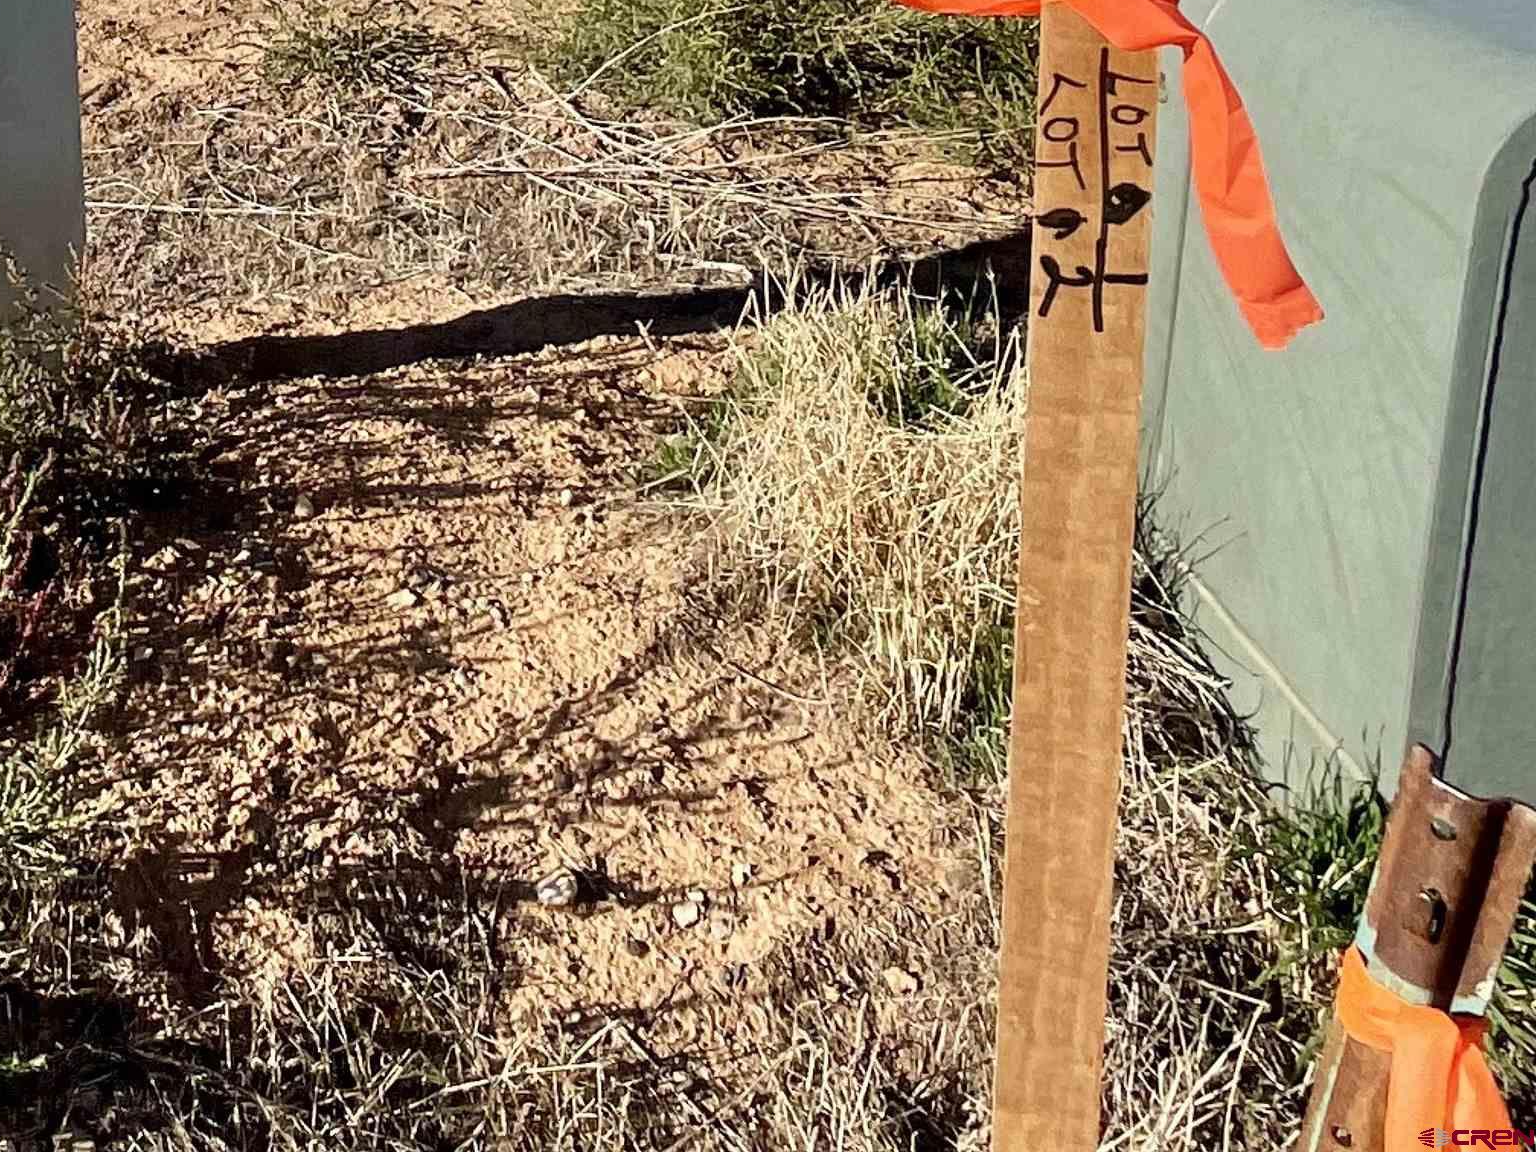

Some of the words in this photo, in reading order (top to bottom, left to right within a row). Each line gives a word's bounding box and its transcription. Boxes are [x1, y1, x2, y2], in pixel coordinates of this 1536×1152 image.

[1037, 73, 1087, 190] LOT
[1105, 71, 1154, 167] LOT
[1038, 255, 1094, 317] 2
